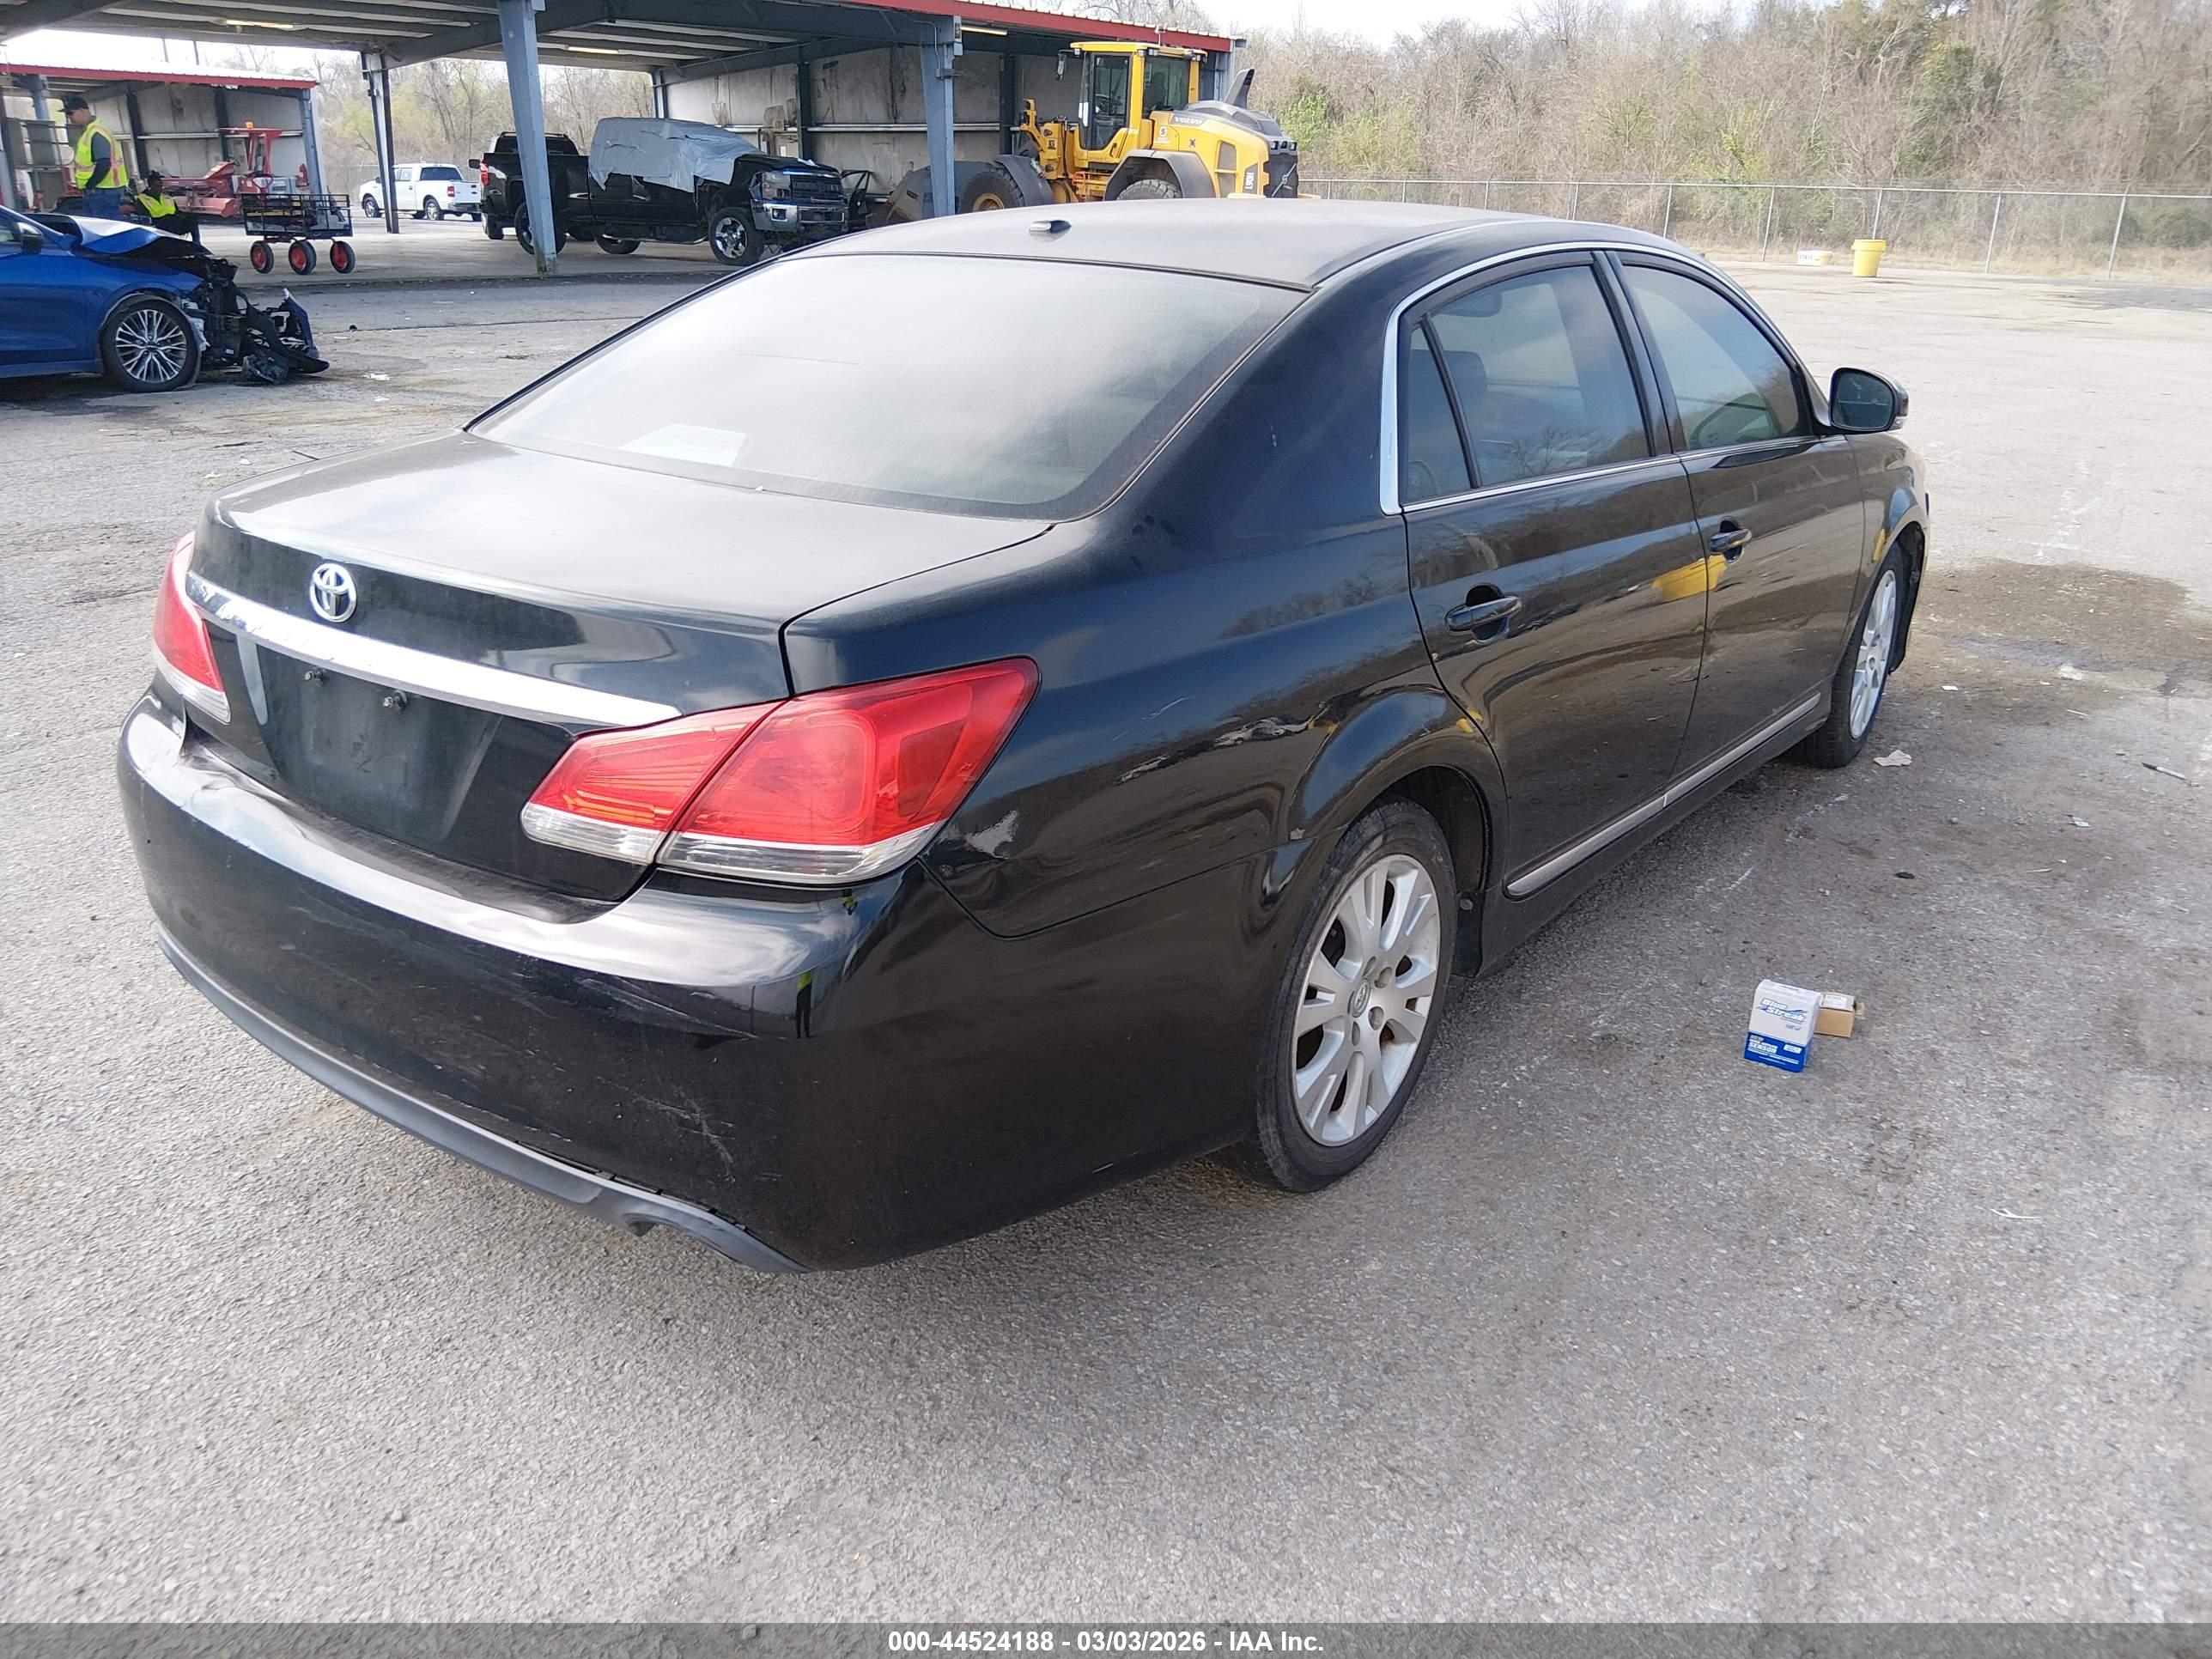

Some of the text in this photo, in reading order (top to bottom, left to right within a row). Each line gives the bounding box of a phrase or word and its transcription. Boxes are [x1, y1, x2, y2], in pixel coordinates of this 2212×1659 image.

[1174, 116, 1203, 125] VOLVO
[1760, 998, 1788, 1010] Blue
[1765, 1006, 1806, 1022] Streak
